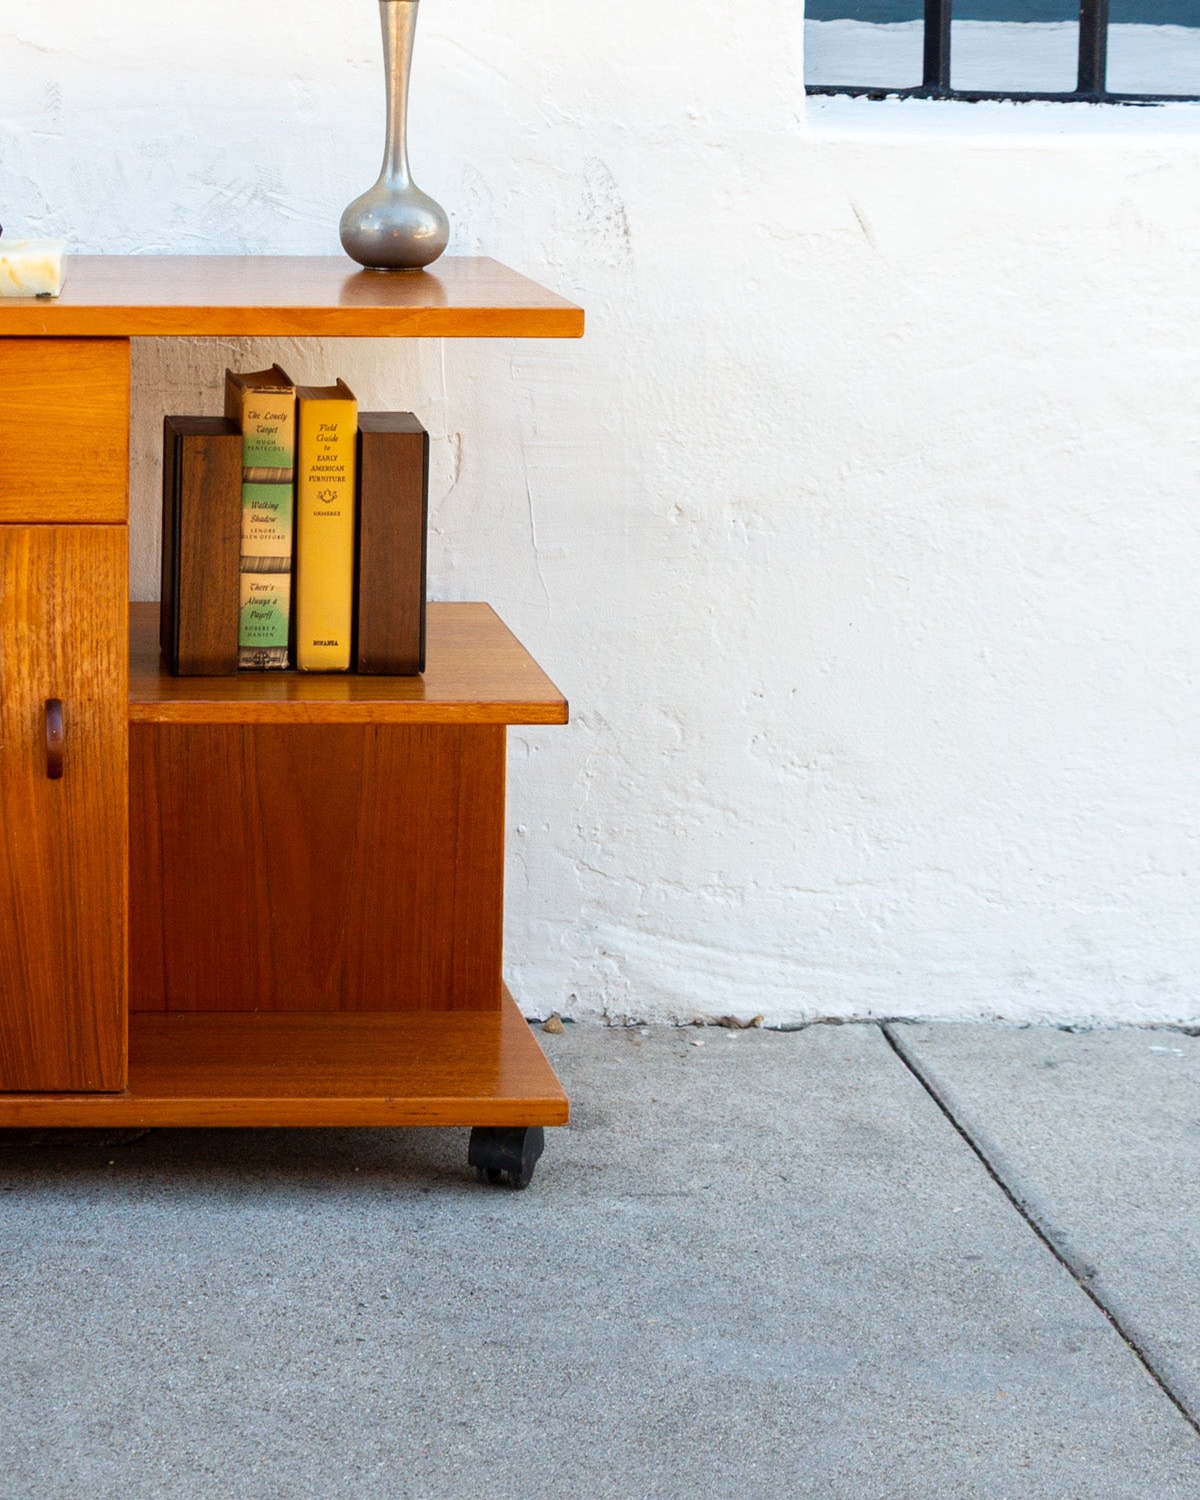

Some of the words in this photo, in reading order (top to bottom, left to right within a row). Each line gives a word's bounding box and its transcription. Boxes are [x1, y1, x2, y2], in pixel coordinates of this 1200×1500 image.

[248, 410, 261, 420] The
[264, 411, 287, 422] Lonely
[256, 424, 279, 435] Target
[319, 423, 338, 432] Field
[316, 433, 339, 442] Guide
[251, 501, 280, 511] Walking
[250, 514, 277, 523] Shadow
[250, 583, 275, 591] There's
[245, 597, 270, 606] Always
[250, 610, 274, 620] Payoff
